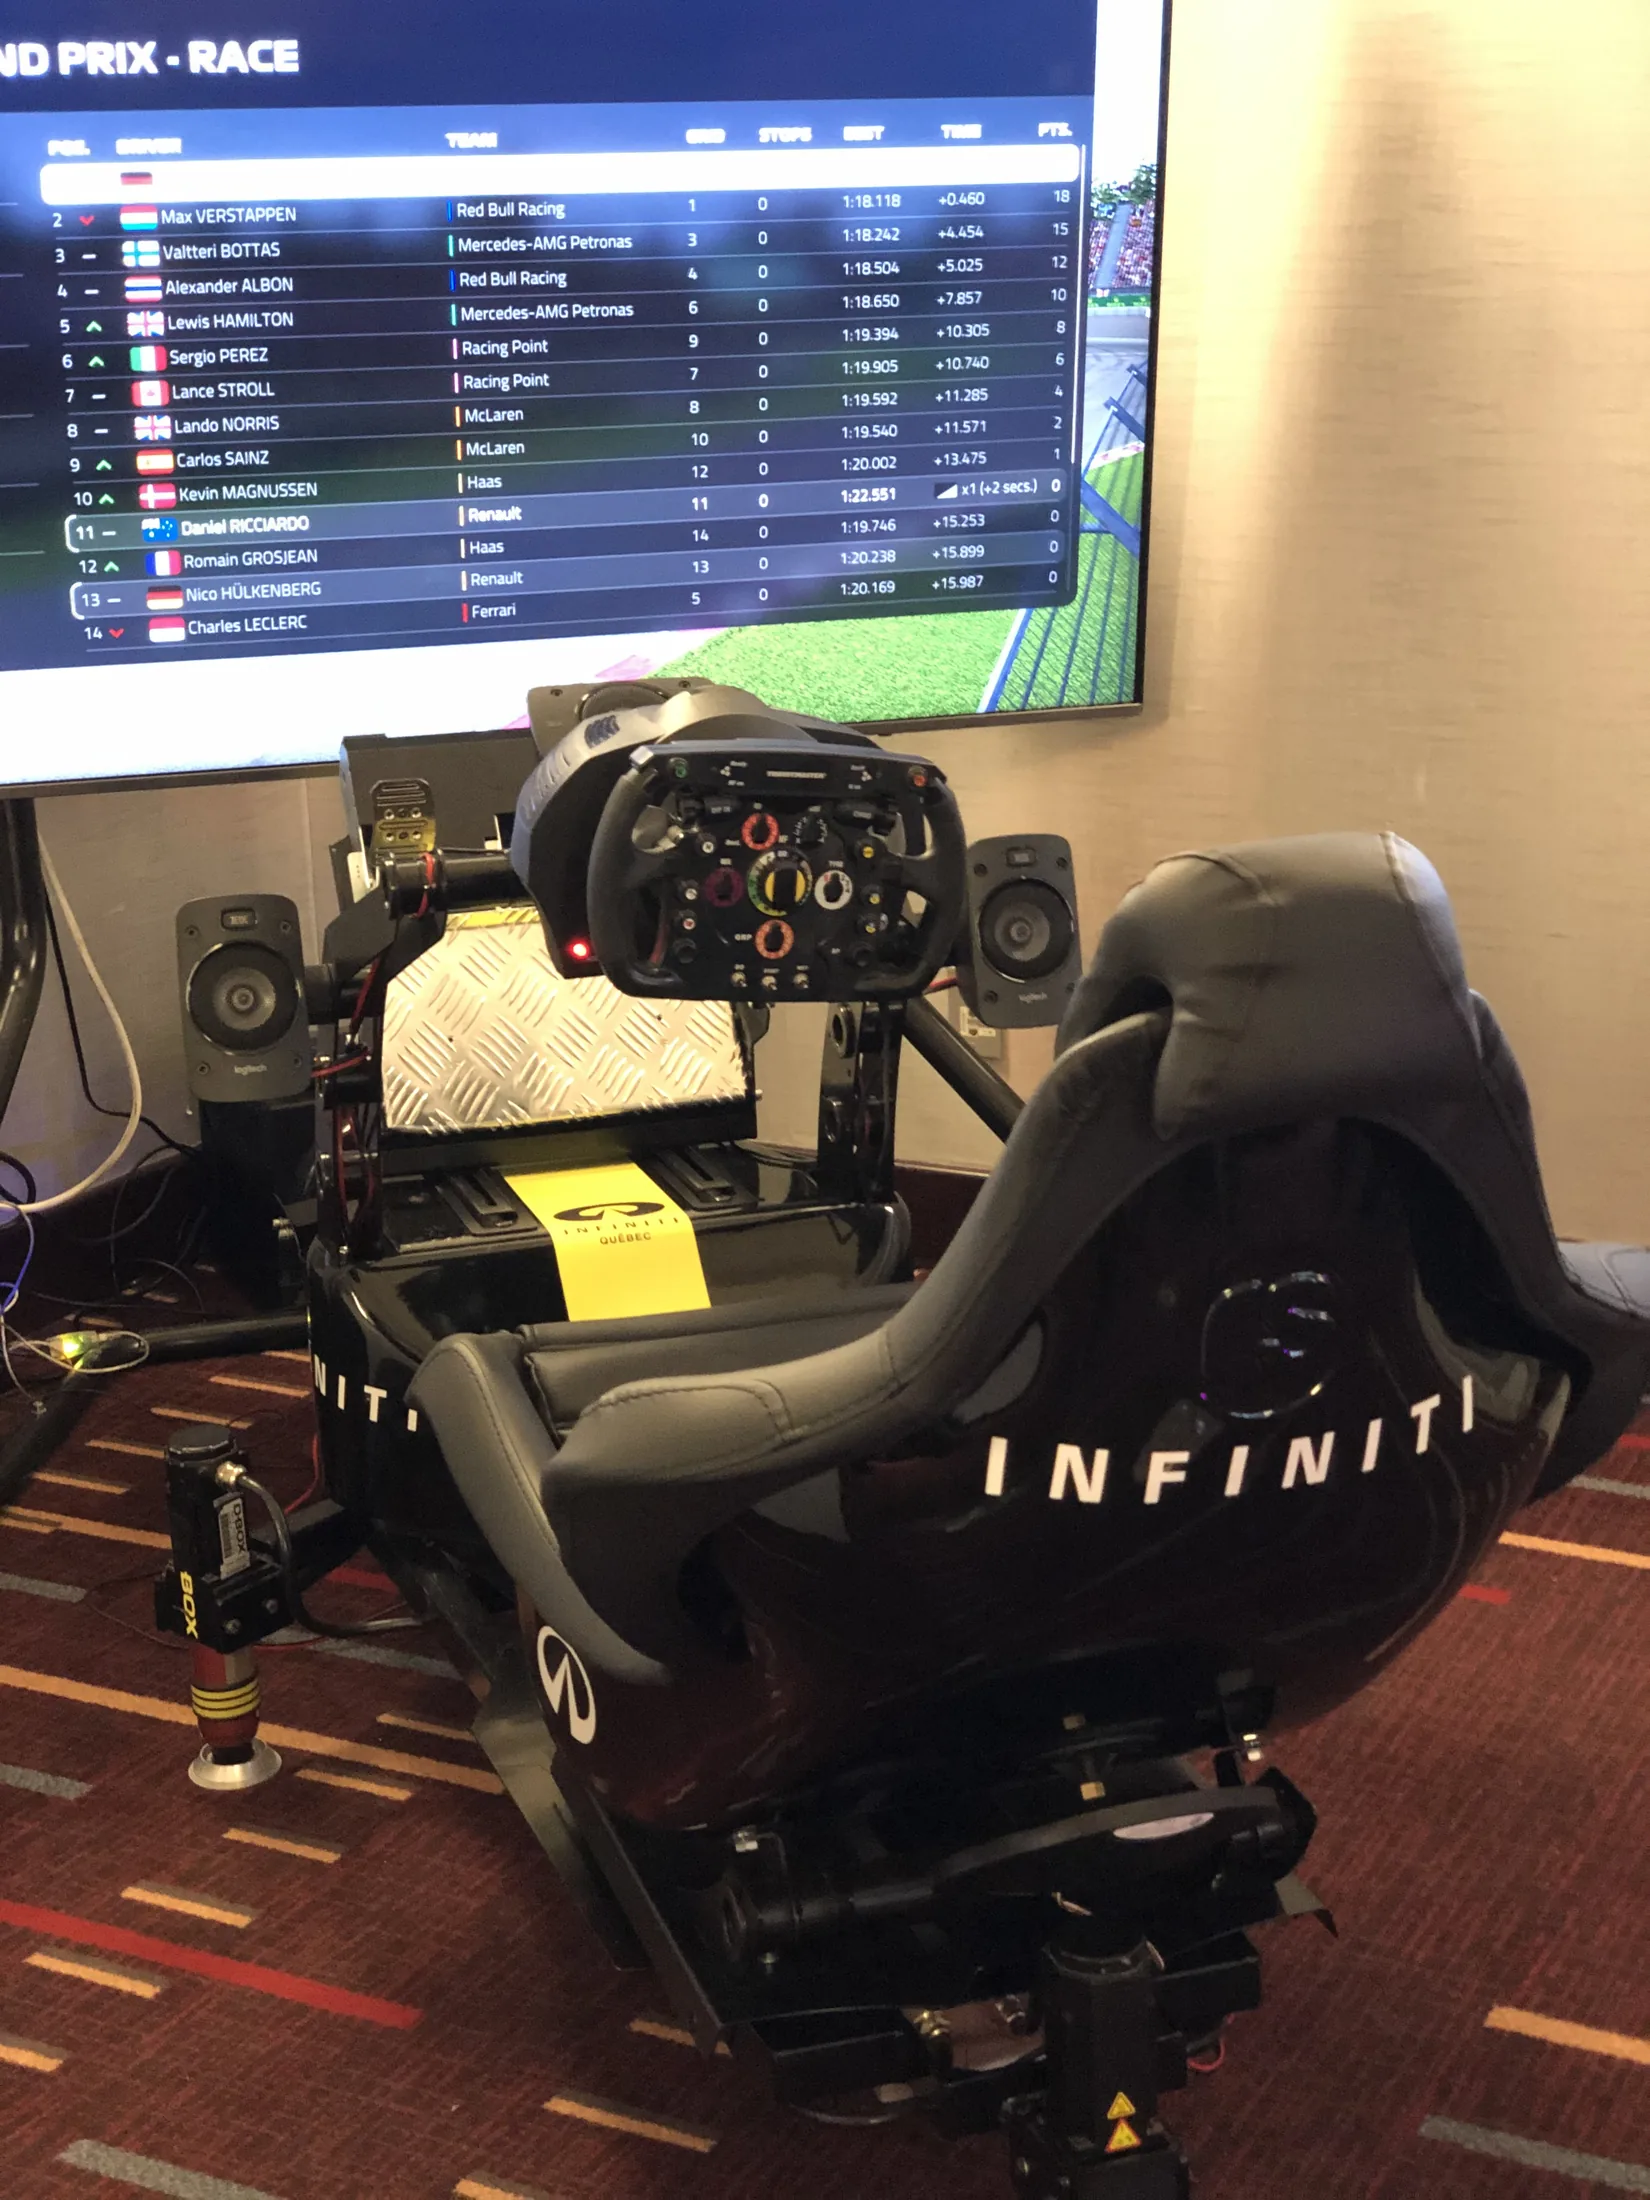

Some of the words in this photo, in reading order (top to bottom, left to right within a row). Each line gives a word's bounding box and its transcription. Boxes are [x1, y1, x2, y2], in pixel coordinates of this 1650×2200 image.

[58, 41, 159, 75] PRIX
[188, 40, 300, 74] RACE
[757, 196, 768, 212] 0
[843, 194, 901, 208] 1:18.118
[939, 192, 985, 206] +0.460
[1053, 189, 1071, 204] 18
[457, 203, 484, 217] Red
[488, 202, 514, 217] Bull
[519, 202, 565, 219] Racing
[688, 198, 696, 212] 1
[52, 212, 63, 228] 2
[161, 210, 192, 224] Max
[196, 207, 296, 223] VERSTAPPEN
[843, 228, 899, 241] 1:18.242
[938, 225, 984, 238] +4.454
[1052, 222, 1069, 236] 15
[459, 236, 566, 252] Mercedes-AMG
[570, 236, 632, 249] Petronas
[687, 232, 698, 247] 3
[757, 230, 768, 245] 0
[55, 247, 66, 264] 3
[163, 244, 216, 259] Valtteri
[221, 242, 280, 258] BOTTAS
[843, 261, 900, 275] 1:18.504
[938, 258, 982, 272] +5.025
[1051, 255, 1068, 269] 12
[687, 267, 699, 281] 4
[758, 264, 769, 279] 0
[166, 279, 238, 294] Alexander
[242, 277, 293, 292] ALBON
[460, 272, 486, 286] Red
[491, 271, 516, 286] Bull
[521, 271, 567, 288] Racing
[57, 283, 68, 298] 4
[937, 291, 982, 305] +7.857
[1050, 287, 1067, 302] 10
[688, 300, 699, 315] 6
[758, 298, 769, 313] 0
[843, 294, 899, 308] 1:18.650
[461, 304, 568, 321] Mercedes-AMG
[572, 304, 634, 317] Petronas
[59, 318, 71, 334] 5
[168, 315, 210, 330] Lewis
[214, 312, 293, 328] HAMILTON
[1055, 320, 1066, 334] 8
[843, 328, 899, 341] 1:19.394
[937, 323, 989, 337] +10.305
[688, 333, 699, 349] 9
[758, 331, 769, 346] 0
[463, 341, 508, 358] Racing
[512, 339, 548, 353] Point
[61, 353, 74, 369] 6
[170, 349, 215, 367] Sergio
[220, 348, 268, 362] PEREZ
[936, 356, 989, 370] +10.740
[1055, 352, 1065, 366] 6
[689, 367, 699, 381] 7
[758, 364, 769, 379] 0
[843, 360, 898, 374] 1:19.905
[464, 374, 510, 391] Racing
[513, 373, 549, 387] Point
[64, 388, 75, 403] 7
[173, 385, 214, 399] Lance
[218, 382, 275, 397] STROLL
[936, 388, 988, 402] +11.285
[1054, 385, 1064, 397] 4
[758, 397, 769, 412] 0
[842, 392, 897, 406] 1:19.592
[689, 400, 700, 414] 8
[465, 409, 523, 422] McLaren
[1053, 415, 1063, 430] 2
[66, 423, 79, 438] 8
[175, 418, 218, 433] Lando
[223, 416, 279, 431] NORRIS
[842, 424, 897, 438] 1:19.540
[935, 420, 986, 434] +11.571
[691, 432, 709, 447] 10
[758, 429, 769, 444] 0
[467, 442, 524, 455] McLaren
[1053, 447, 1060, 460] 1
[69, 457, 81, 473] 9
[177, 453, 222, 467] Carlos
[225, 450, 269, 465] SAINZ
[842, 456, 896, 470] 1:20.002
[934, 451, 987, 465] +13.475
[691, 464, 709, 479] 12
[758, 461, 769, 476] 0
[468, 476, 502, 488] Haas
[961, 482, 976, 496] x1
[980, 481, 1000, 496] (+2
[1003, 478, 1037, 493] secs.)
[1051, 478, 1062, 493] 0
[73, 491, 93, 506] 10
[179, 487, 218, 501] Kevin
[222, 482, 317, 499] MAGNUSSEN
[841, 488, 895, 503] 1:22.551
[691, 496, 708, 511] 11
[758, 493, 769, 508] 0
[468, 506, 522, 522] Renault
[934, 514, 985, 528] +15.253
[1050, 509, 1060, 523] 0
[75, 525, 94, 541] 11
[181, 519, 226, 536] Daniel
[230, 515, 309, 533] RICCIARDO
[758, 525, 769, 539] 0
[842, 519, 896, 533] 1:19.746
[692, 528, 710, 542] 14
[470, 541, 504, 554] Haas
[933, 545, 984, 558] +15.899
[1049, 539, 1059, 554] 0
[184, 553, 238, 568] Romain
[242, 549, 317, 565] GROSJEAN
[758, 556, 769, 570] 0
[841, 550, 896, 564] 1:20.238
[78, 559, 98, 574] 12
[692, 559, 710, 574] 13
[471, 571, 523, 586] Renault
[932, 575, 983, 589] +15.987
[1048, 570, 1058, 584] 0
[186, 588, 217, 601] Nico
[221, 581, 321, 600] HÜLKENBERG
[758, 587, 769, 601] 0
[841, 581, 895, 595] 1:20.169
[81, 592, 101, 608] 13
[691, 591, 701, 606] 5
[472, 603, 516, 618] Ferrari
[188, 620, 241, 634] Charles
[245, 615, 307, 631] LECLERC
[84, 626, 103, 640] 14
[563, 1217, 679, 1235] INFINITI
[599, 1231, 652, 1246] QUÉBEC
[984, 1374, 1474, 1505] INFINITI
